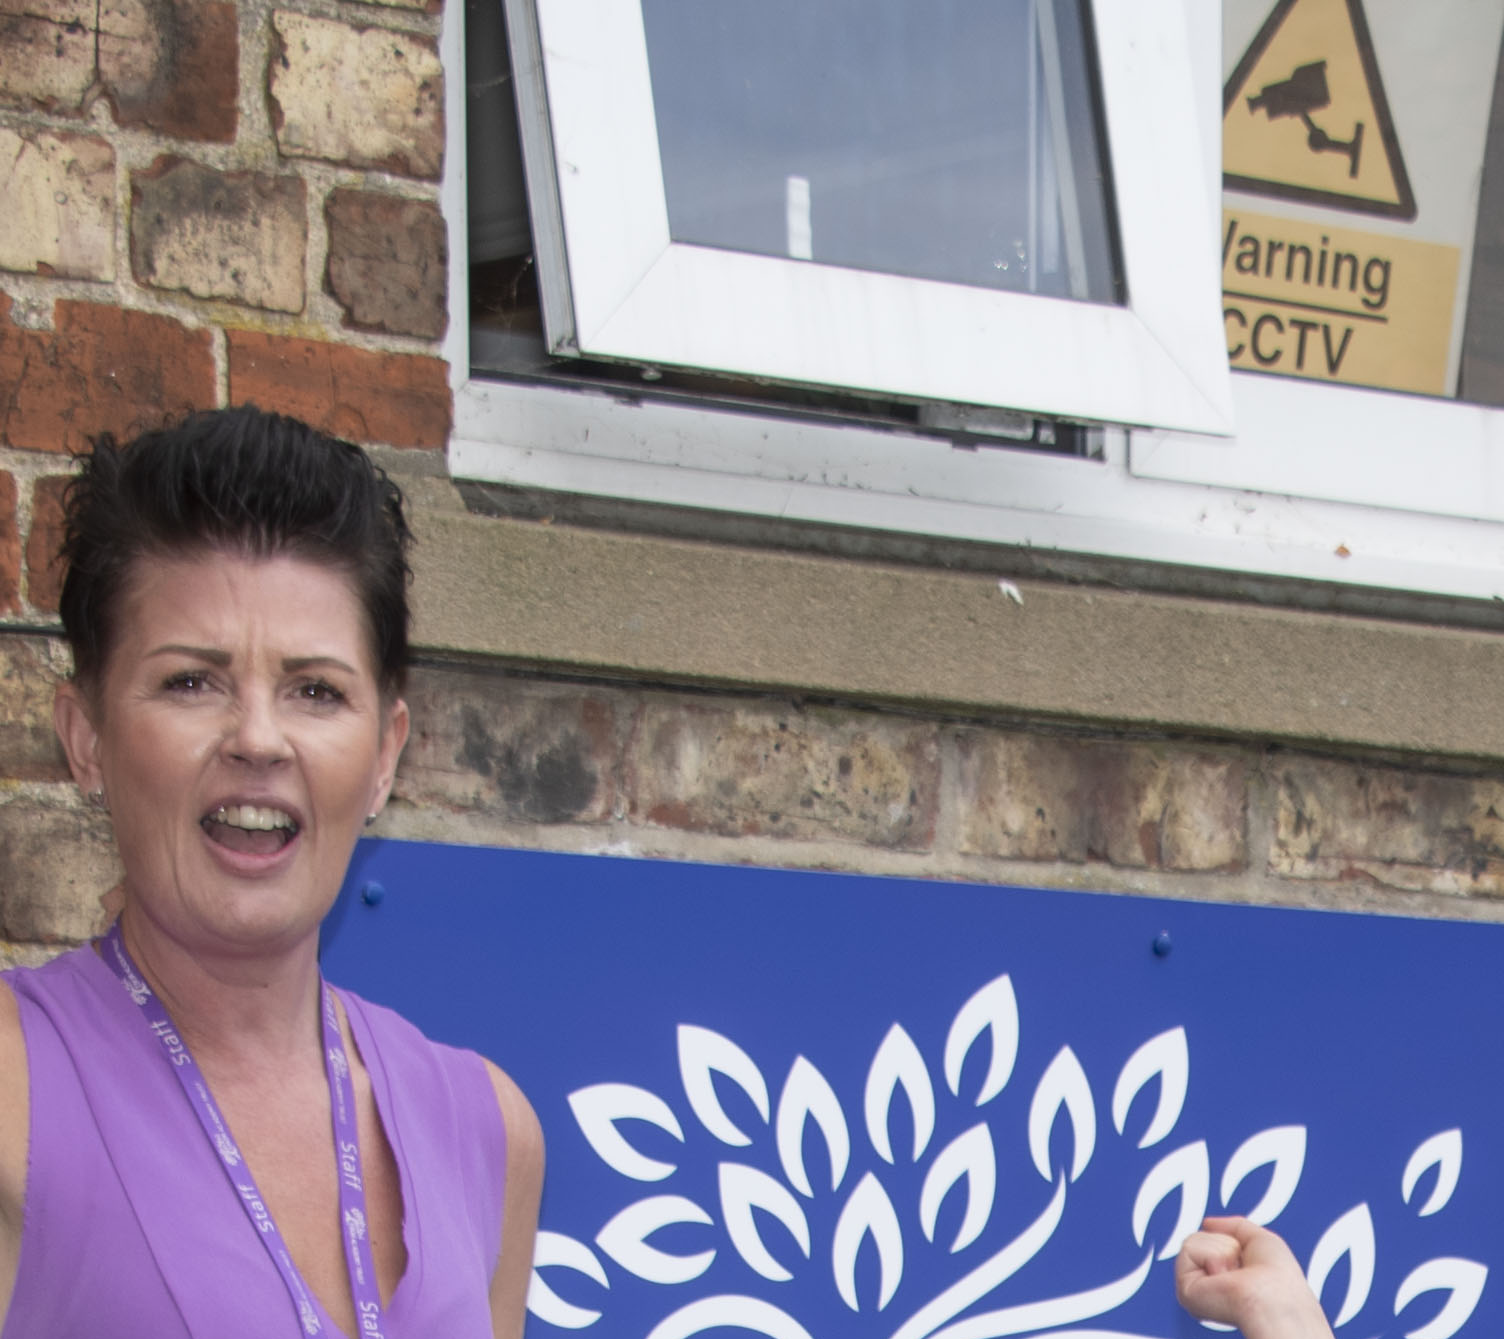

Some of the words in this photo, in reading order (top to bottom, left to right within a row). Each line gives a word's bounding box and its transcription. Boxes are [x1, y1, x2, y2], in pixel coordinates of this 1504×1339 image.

[1222, 308, 1353, 376] CCTV
[150, 1019, 191, 1067] Staff
[341, 1142, 363, 1192] Staff
[238, 1183, 275, 1233] Staff
